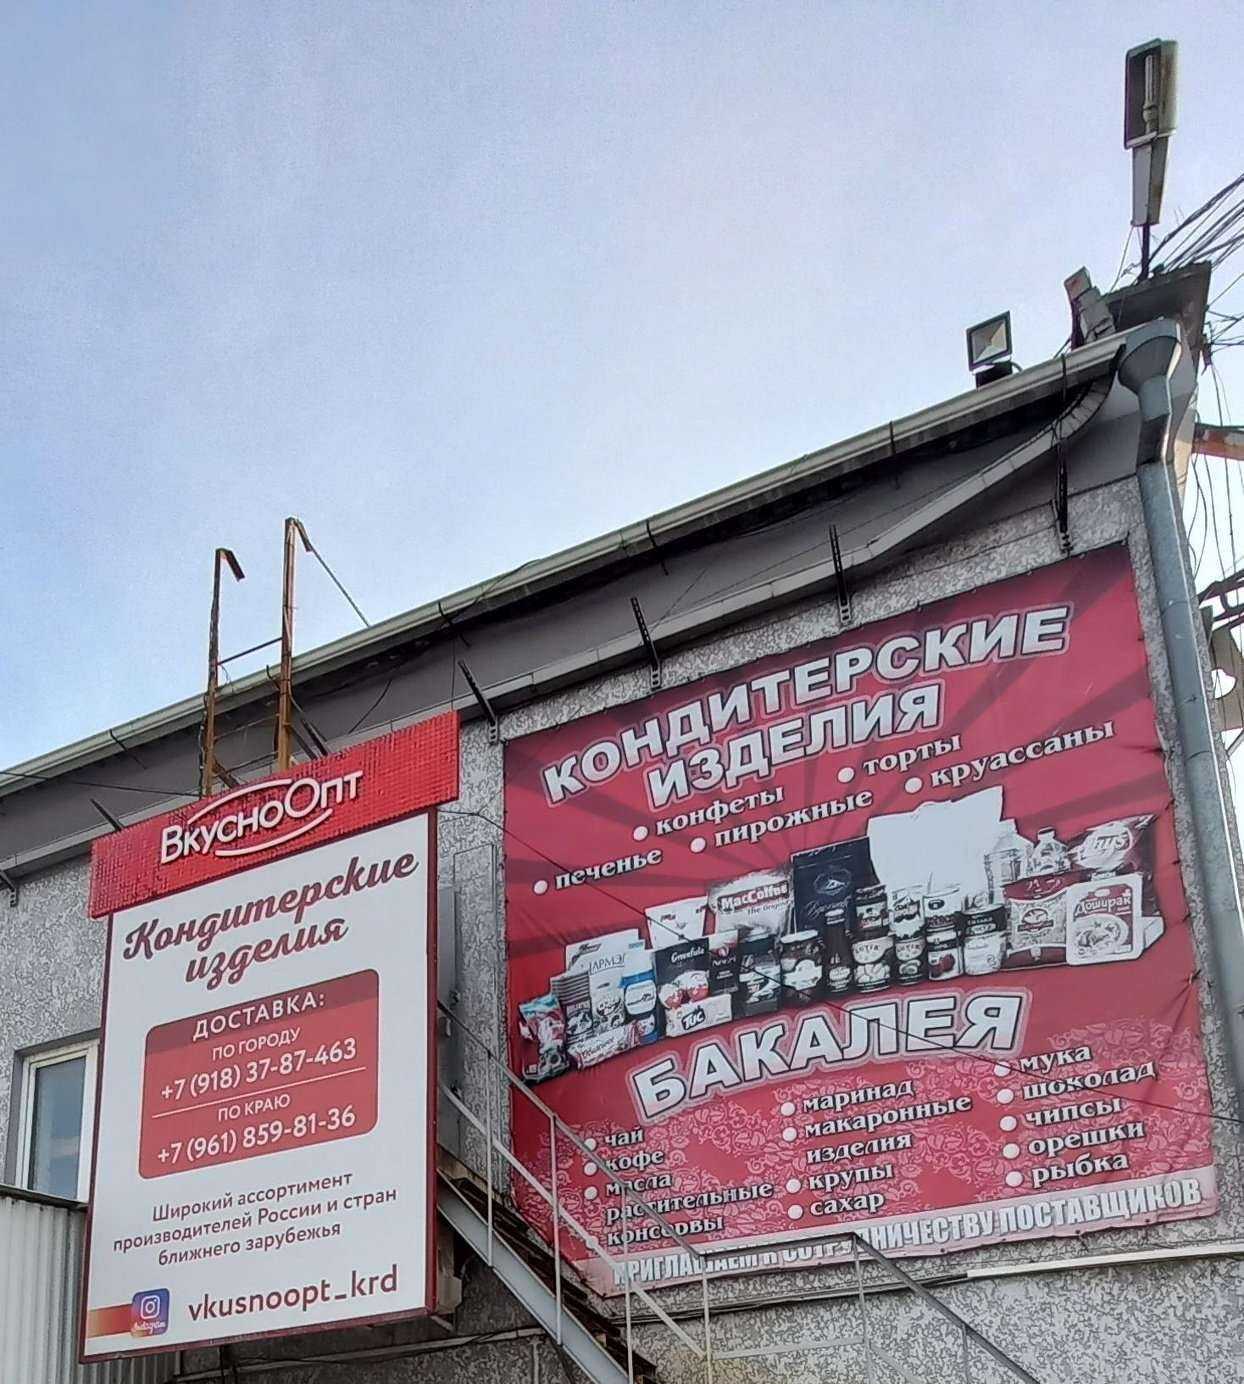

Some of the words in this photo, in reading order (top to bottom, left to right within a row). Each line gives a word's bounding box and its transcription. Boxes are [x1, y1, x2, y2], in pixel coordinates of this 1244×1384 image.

[544, 606, 1068, 804] КОНДИТЕРСКИЕ
[648, 685, 941, 810] ИЗДЕЛИЯ
[555, 848, 662, 889] печенье
[713, 788, 874, 848] пирожные
[930, 718, 1115, 788] круассаны
[655, 786, 784, 838] конфеты
[861, 735, 962, 778] торты
[123, 851, 419, 961] Кондитерские
[1073, 895, 1131, 917] Доширак
[185, 917, 349, 990] изделия
[193, 991, 326, 1041] ДОСТАВКА:
[212, 1044, 235, 1061] ПО
[238, 1028, 301, 1057] ГОРОДУ
[633, 995, 1022, 1119] БАКАЛЕЯ
[1020, 1046, 1091, 1074] мука
[161, 1079, 187, 1102] +7
[190, 1065, 242, 1098] (918)
[246, 1037, 357, 1085] 37-87-463
[1022, 1061, 1157, 1101] шоколад
[218, 1105, 241, 1122] ПО
[244, 1094, 291, 1118] КРАЮ
[803, 1081, 915, 1114] маринад
[805, 1095, 972, 1138] макаронные
[1025, 1097, 1121, 1127] чипсы
[157, 1142, 183, 1166] +7
[186, 1128, 238, 1164] (961)
[242, 1105, 356, 1150] 859-81-36
[605, 1128, 643, 1148] чай
[807, 1133, 912, 1165] изделия
[1028, 1121, 1145, 1157] орешки
[606, 1149, 664, 1175] кофе
[808, 1162, 894, 1191] крупы
[1031, 1152, 1128, 1188] рыбка
[152, 1191, 233, 1224] Широкий
[237, 1172, 353, 1210] ассортимент
[810, 1193, 885, 1216] сахар
[1000, 1178, 1202, 1232] ПОСТАВЩИКОВ
[113, 1212, 252, 1254] производителей
[257, 1203, 323, 1227] России
[327, 1199, 338, 1213] и
[343, 1187, 398, 1215] стран
[158, 1240, 241, 1268] ближнего
[245, 1222, 342, 1254] зарубежья
[188, 1263, 398, 1322] vkusnoopt_krd
